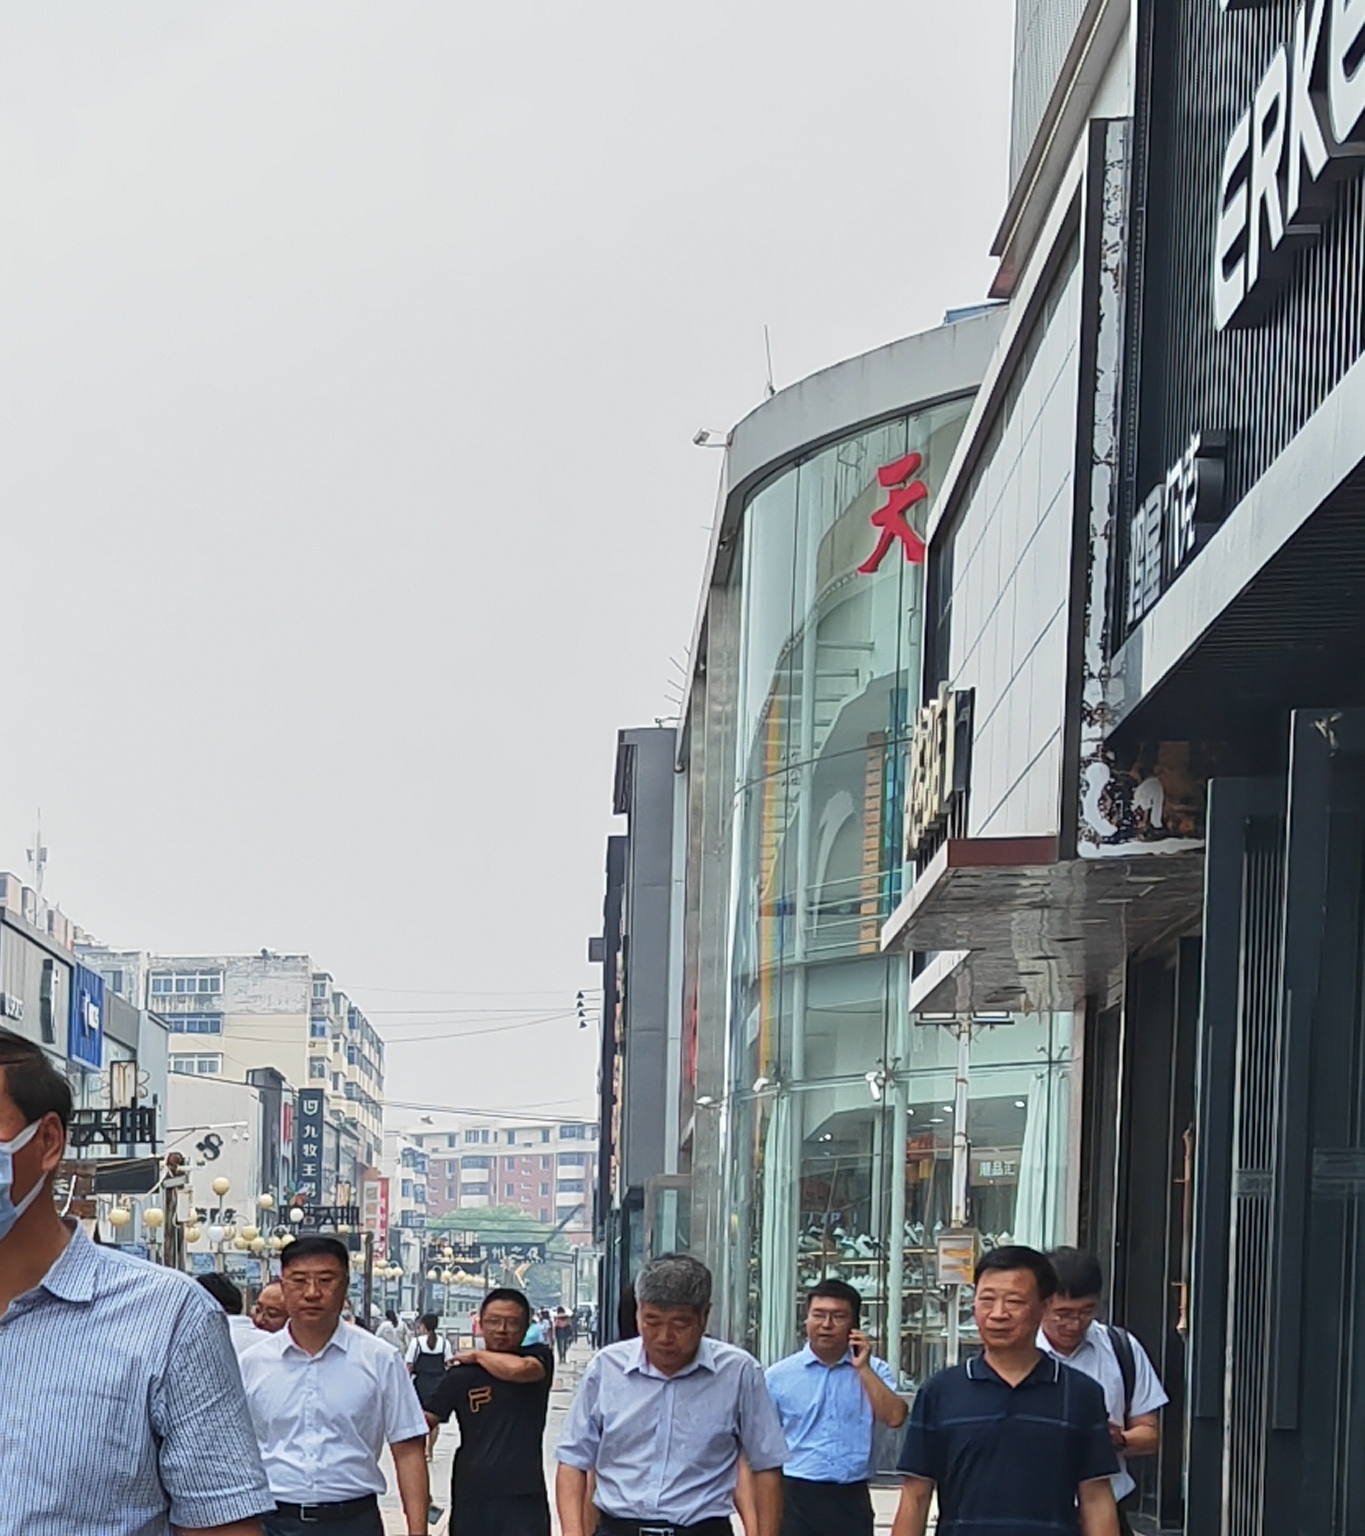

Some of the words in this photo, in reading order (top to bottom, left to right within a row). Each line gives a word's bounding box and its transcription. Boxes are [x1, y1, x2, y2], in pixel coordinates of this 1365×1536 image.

[857, 452, 925, 573] 天
[302, 1123, 319, 1225] 九牧王男
